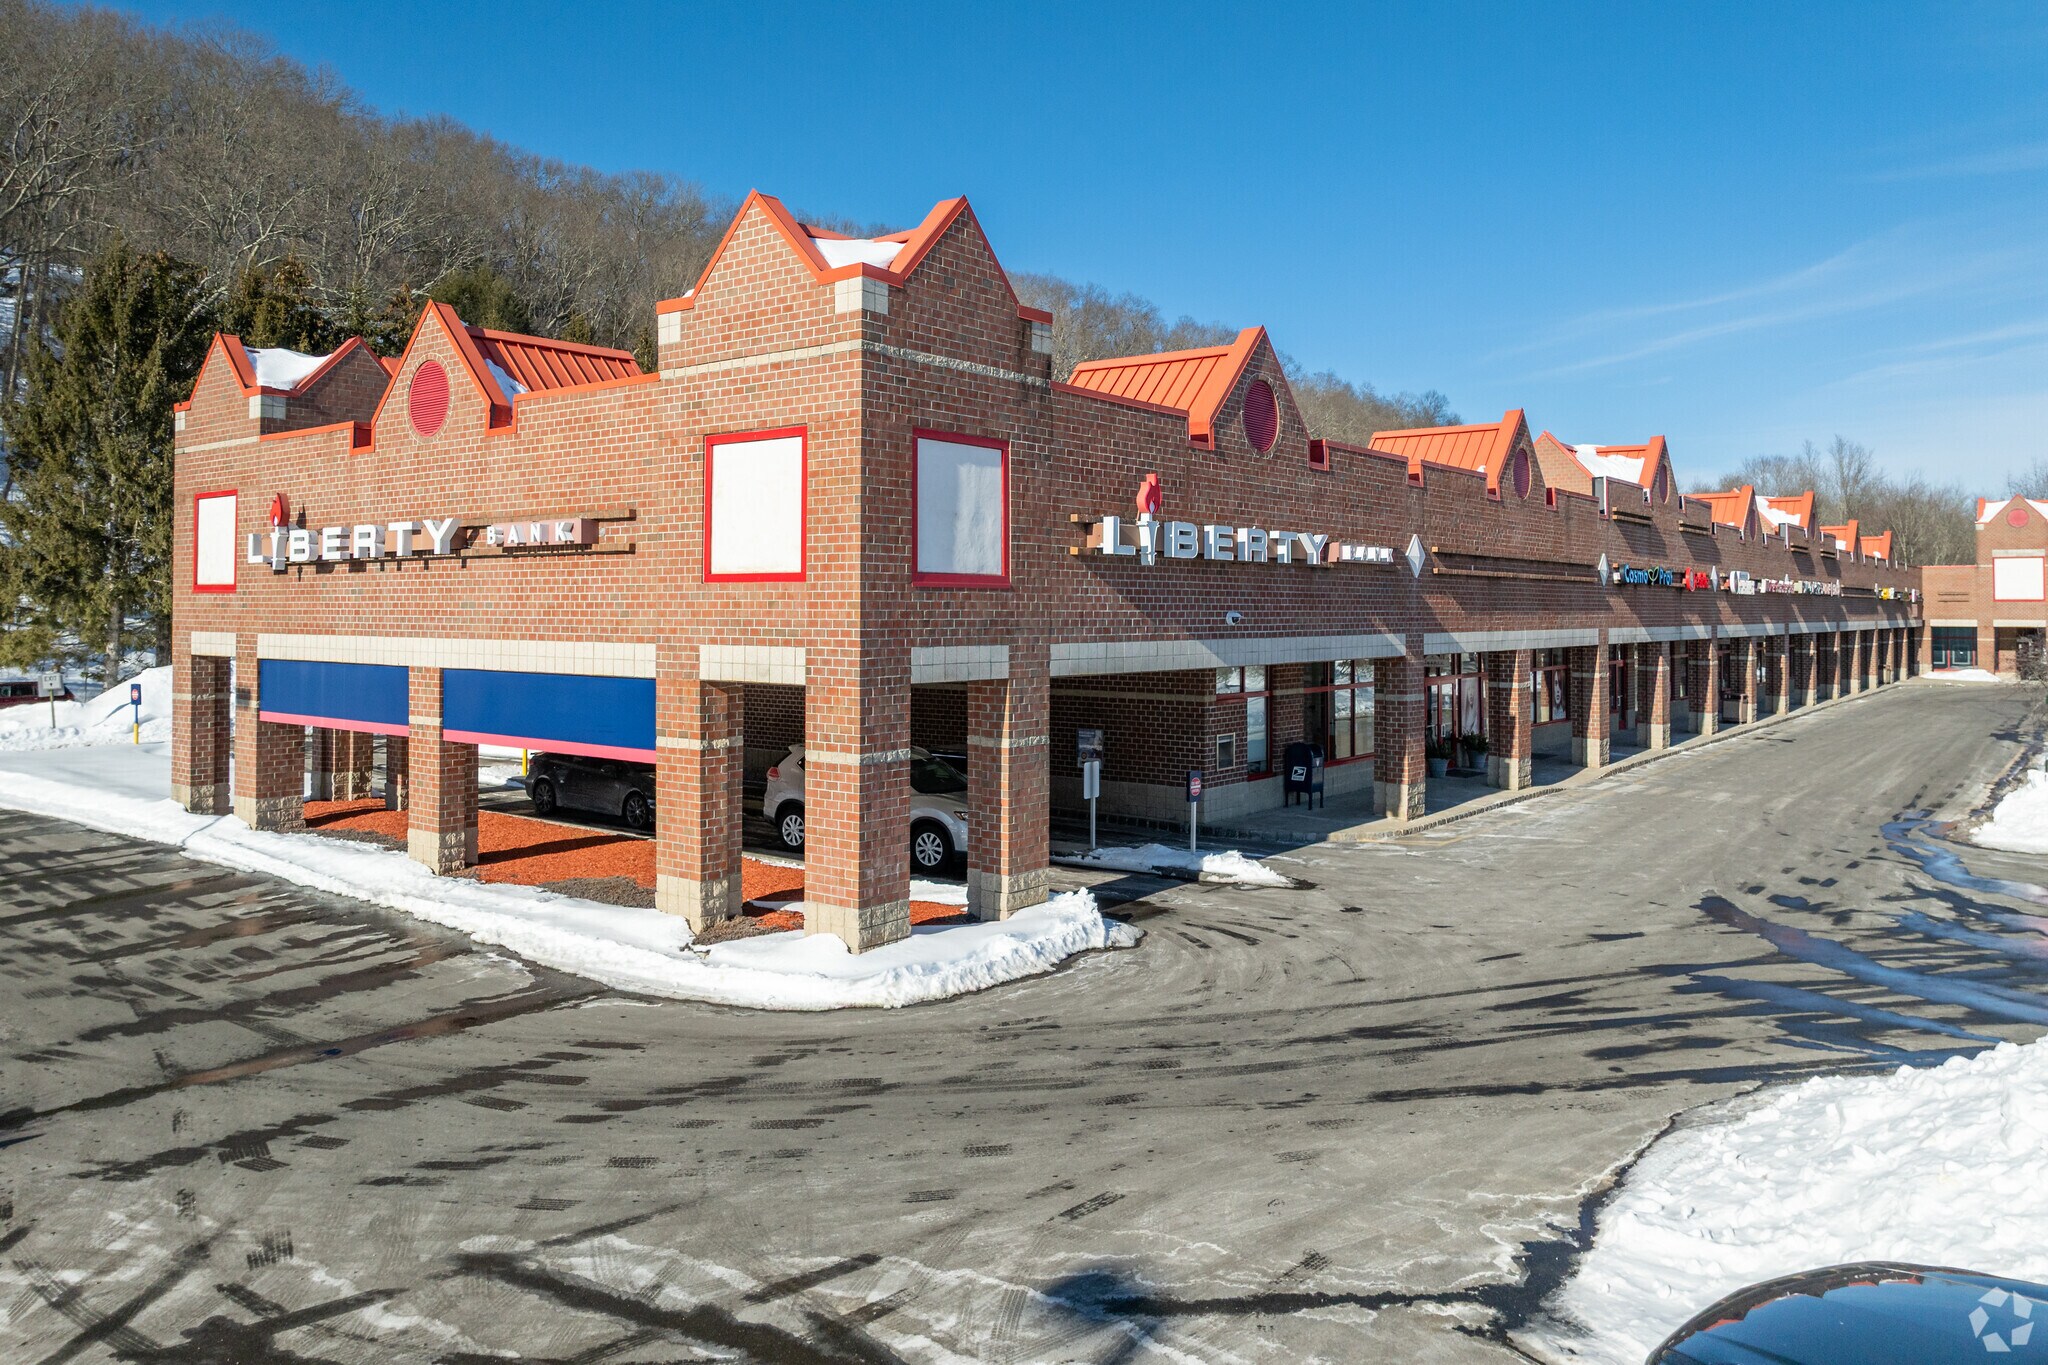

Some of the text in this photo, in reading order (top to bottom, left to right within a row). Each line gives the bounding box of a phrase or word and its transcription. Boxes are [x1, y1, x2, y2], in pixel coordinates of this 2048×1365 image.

[248, 517, 575, 570] LIBERTY BANK
[1102, 511, 1328, 566] LIBERTY
